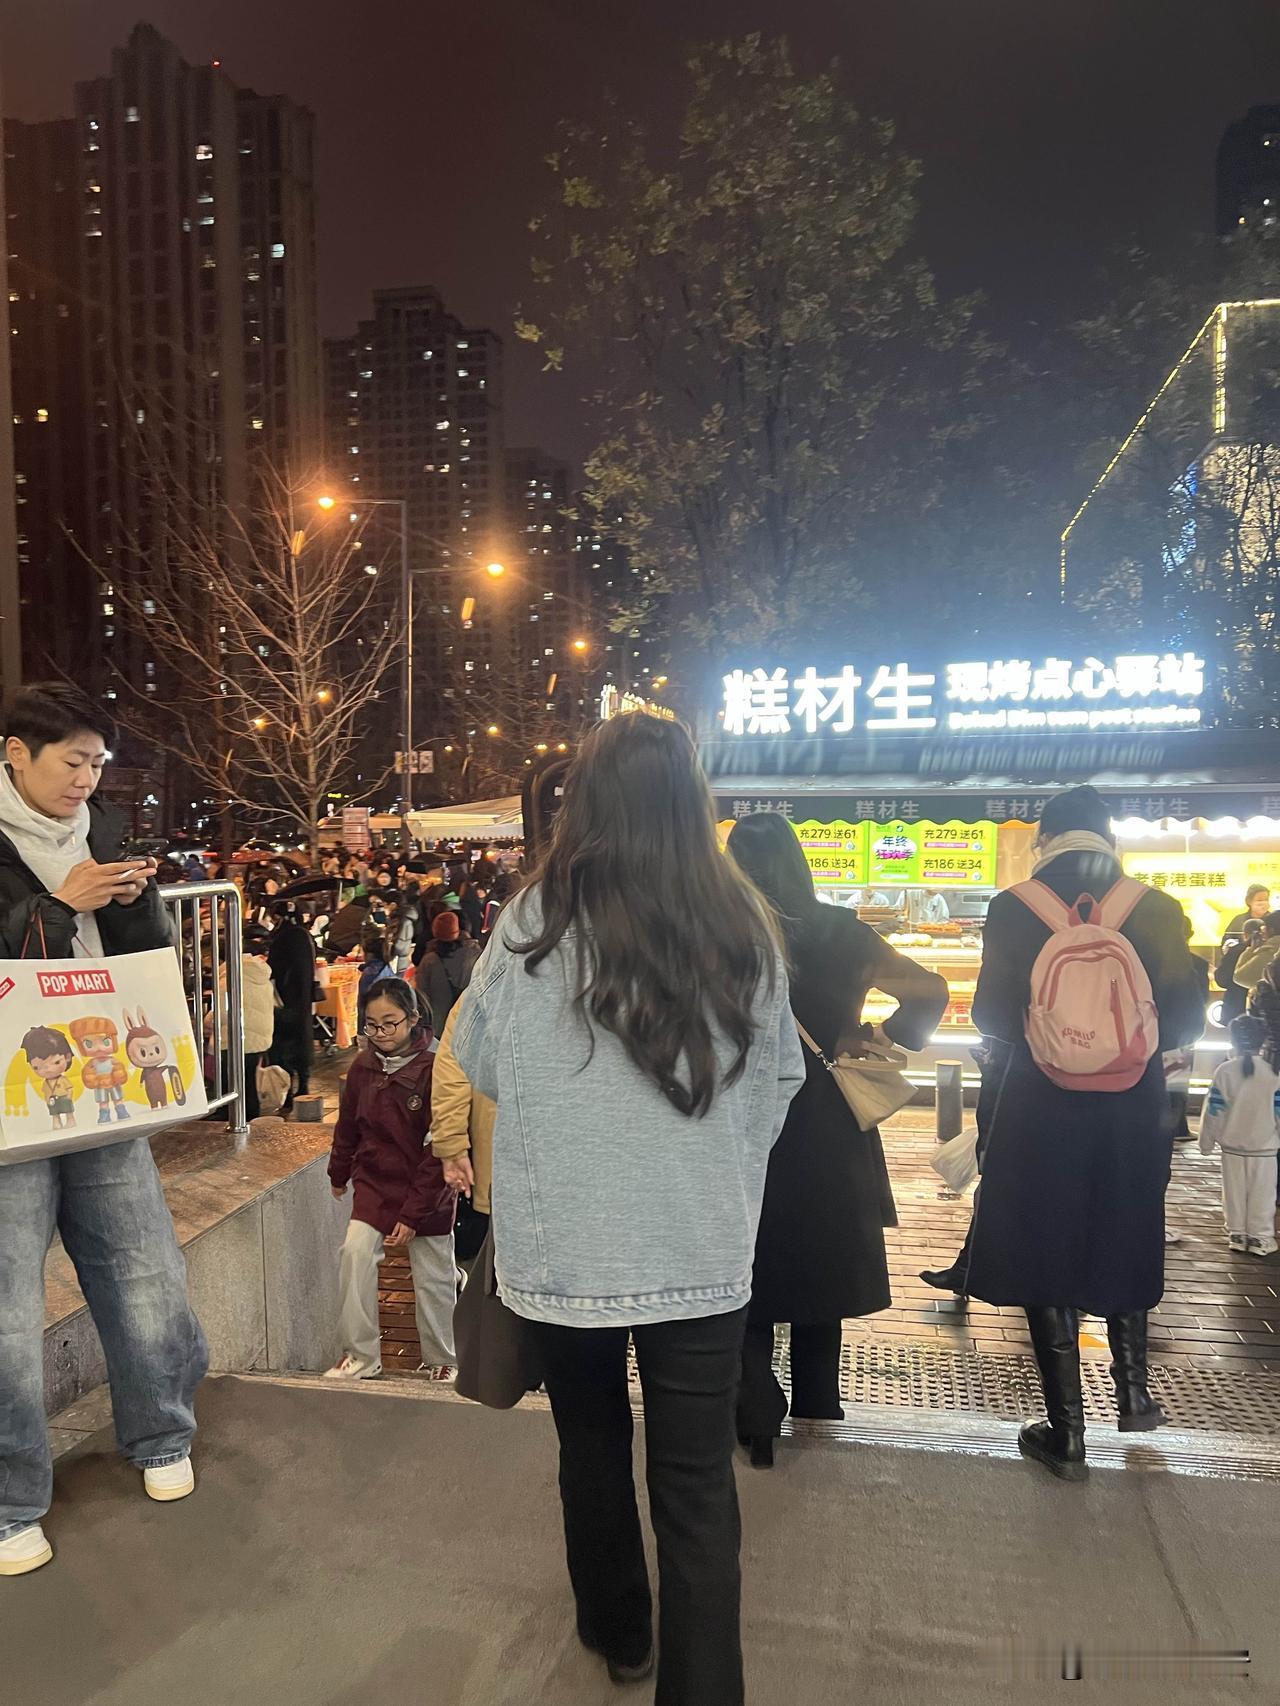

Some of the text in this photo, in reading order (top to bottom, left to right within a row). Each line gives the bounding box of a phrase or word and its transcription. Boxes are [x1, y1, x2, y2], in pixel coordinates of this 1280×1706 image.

[722, 663, 937, 735] 糕材生
[856, 800, 920, 819] 糕材生
[1121, 797, 1190, 817] 糕材生
[883, 835, 908, 847] 年终
[41, 973, 110, 994] POP MART
